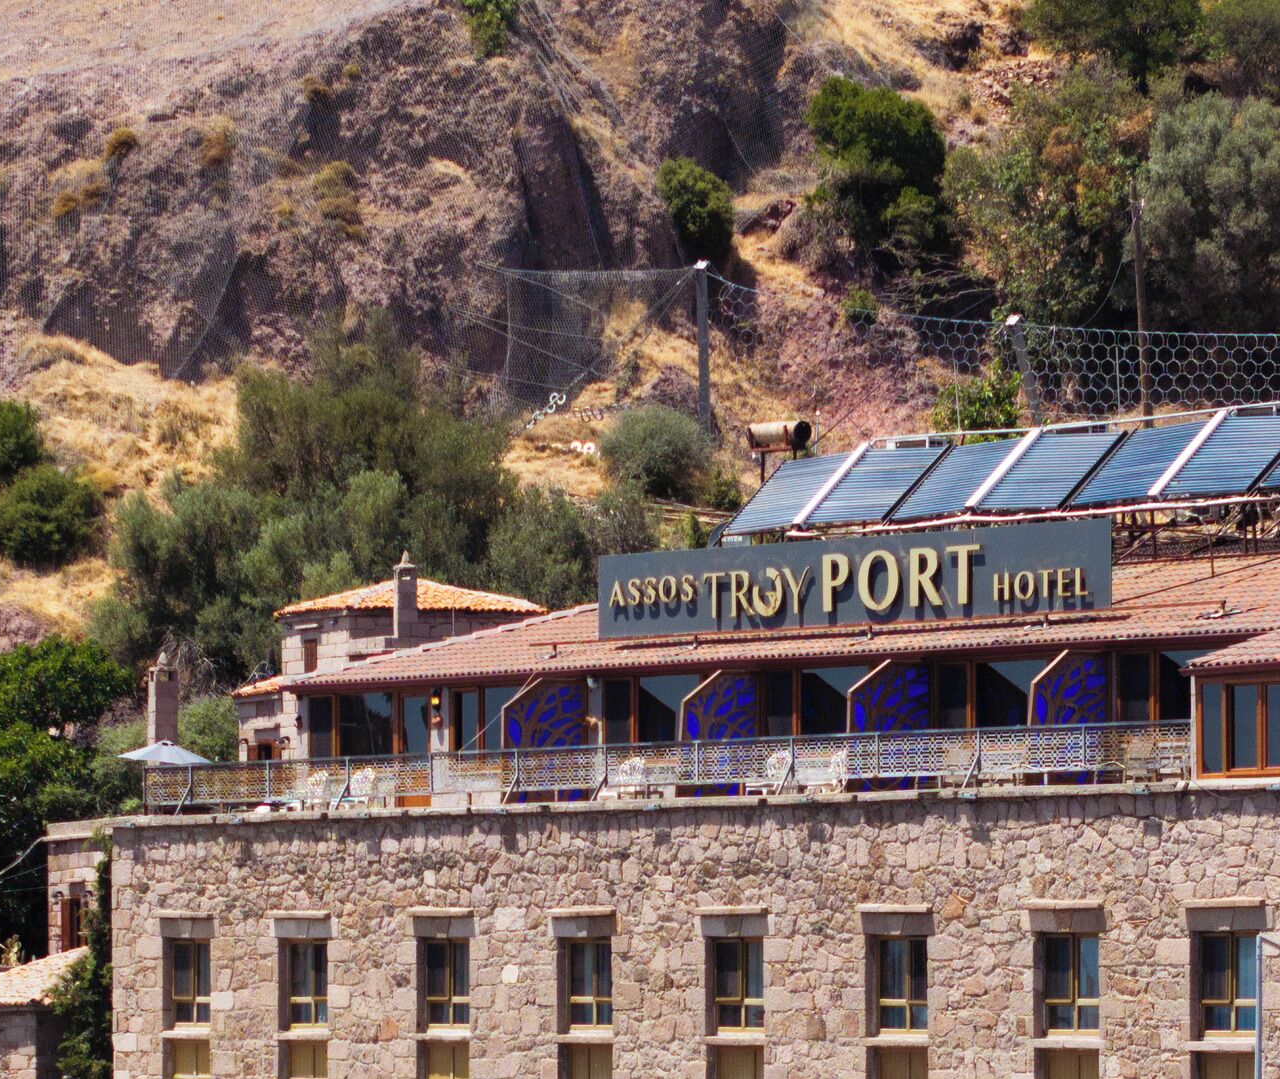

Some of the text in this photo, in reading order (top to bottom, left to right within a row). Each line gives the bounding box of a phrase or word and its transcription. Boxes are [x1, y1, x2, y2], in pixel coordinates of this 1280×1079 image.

[609, 574, 695, 608] ASSOS
[822, 544, 981, 612] PORT
[993, 567, 1090, 601] HOTEL
